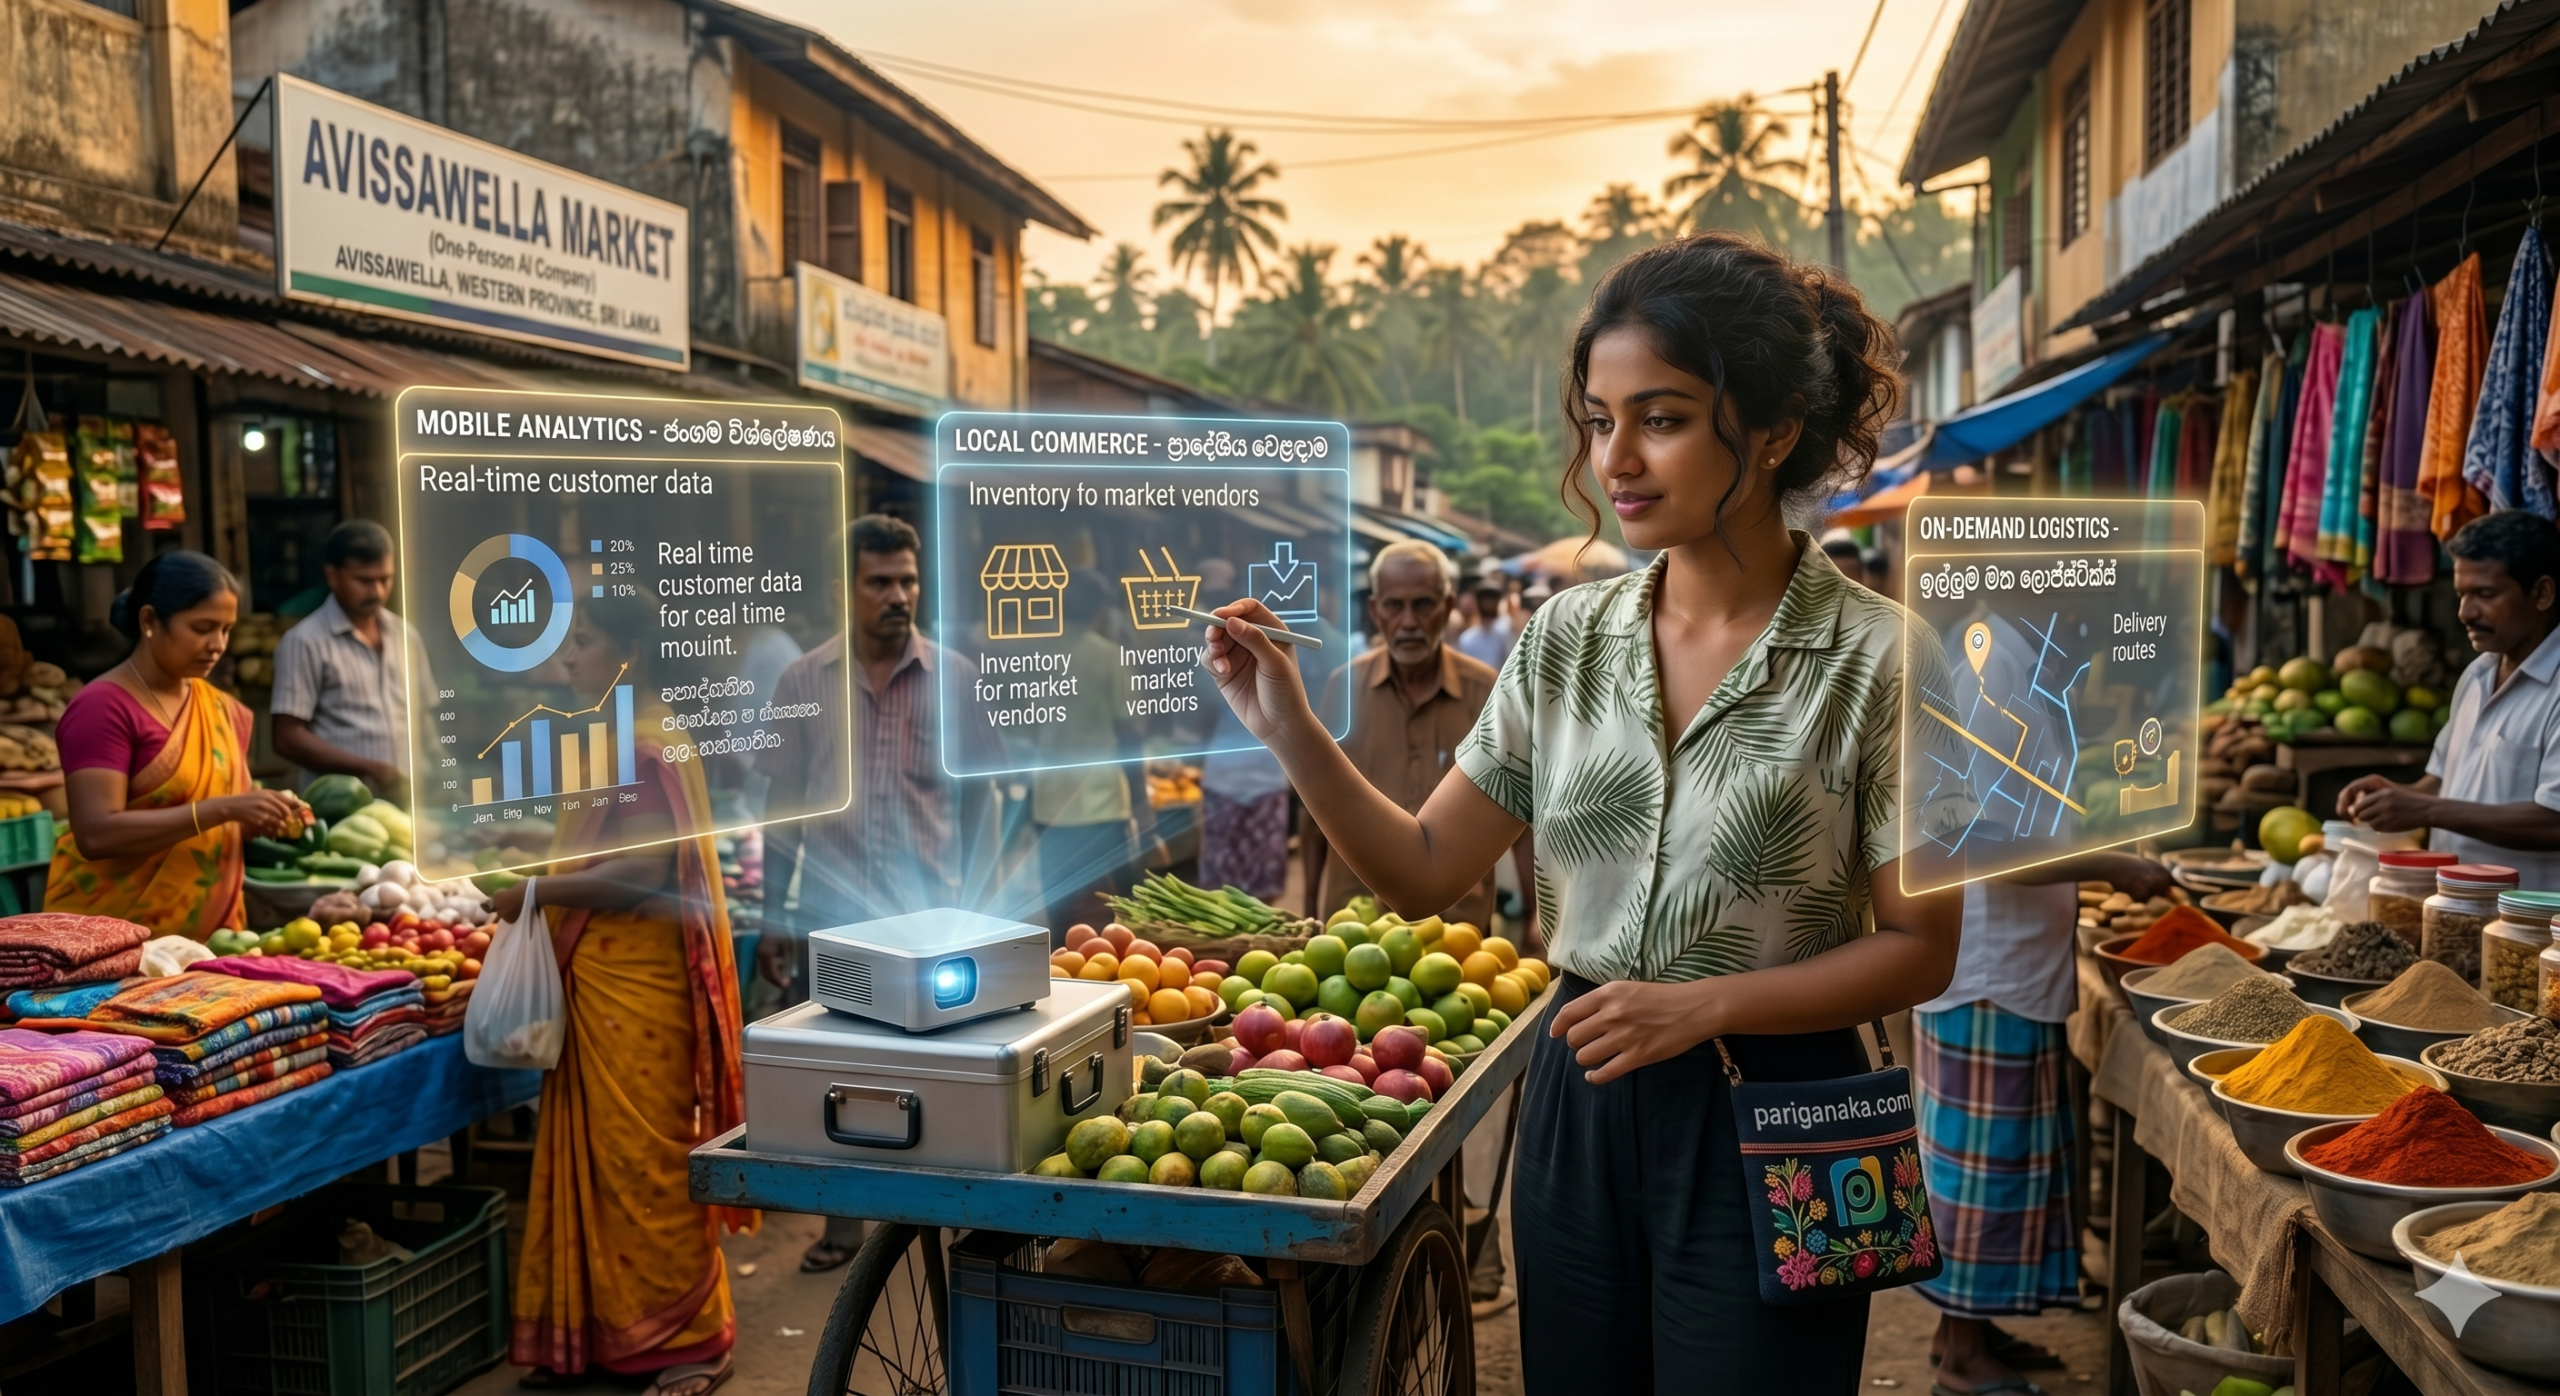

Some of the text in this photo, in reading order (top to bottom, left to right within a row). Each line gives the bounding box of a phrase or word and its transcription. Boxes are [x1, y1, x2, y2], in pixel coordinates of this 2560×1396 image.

[303, 117, 676, 281] AVISSAWELLA MARKET
[429, 229, 514, 272] (One-Person
[535, 257, 597, 296] Company)
[335, 244, 662, 336] AVISSAWELLA, WESTERN PROVINCE, SRI LANKA
[416, 409, 511, 437] MOBILE
[517, 413, 643, 442] ANALYTICS
[955, 428, 1025, 453] LOCAL
[1030, 430, 1149, 455] COMMERCE
[420, 464, 713, 495] Real-time customer data
[969, 480, 1259, 512] Inventory fo market vendors
[1920, 516, 2025, 540] ON-DEMAND
[2029, 516, 2110, 539] LOGISTICS
[610, 539, 635, 552] 20%
[658, 540, 754, 565] Real time
[610, 561, 636, 575] 25%
[611, 583, 636, 597] 10%
[658, 569, 802, 597] customer data
[659, 603, 689, 628] for
[741, 601, 786, 624] time
[2113, 611, 2167, 637] Delivery
[980, 651, 1072, 677] Inventory
[1120, 644, 1203, 668] Inventory
[2112, 641, 2156, 662] routes
[974, 675, 1078, 702] for market
[1130, 667, 1194, 692] market
[987, 703, 1067, 727] vendors
[1125, 691, 1199, 716] vendors
[439, 711, 456, 722] 600
[441, 757, 457, 768] 200
[442, 780, 458, 790] 100
[1753, 1093, 1913, 1131] pariganaka.com
